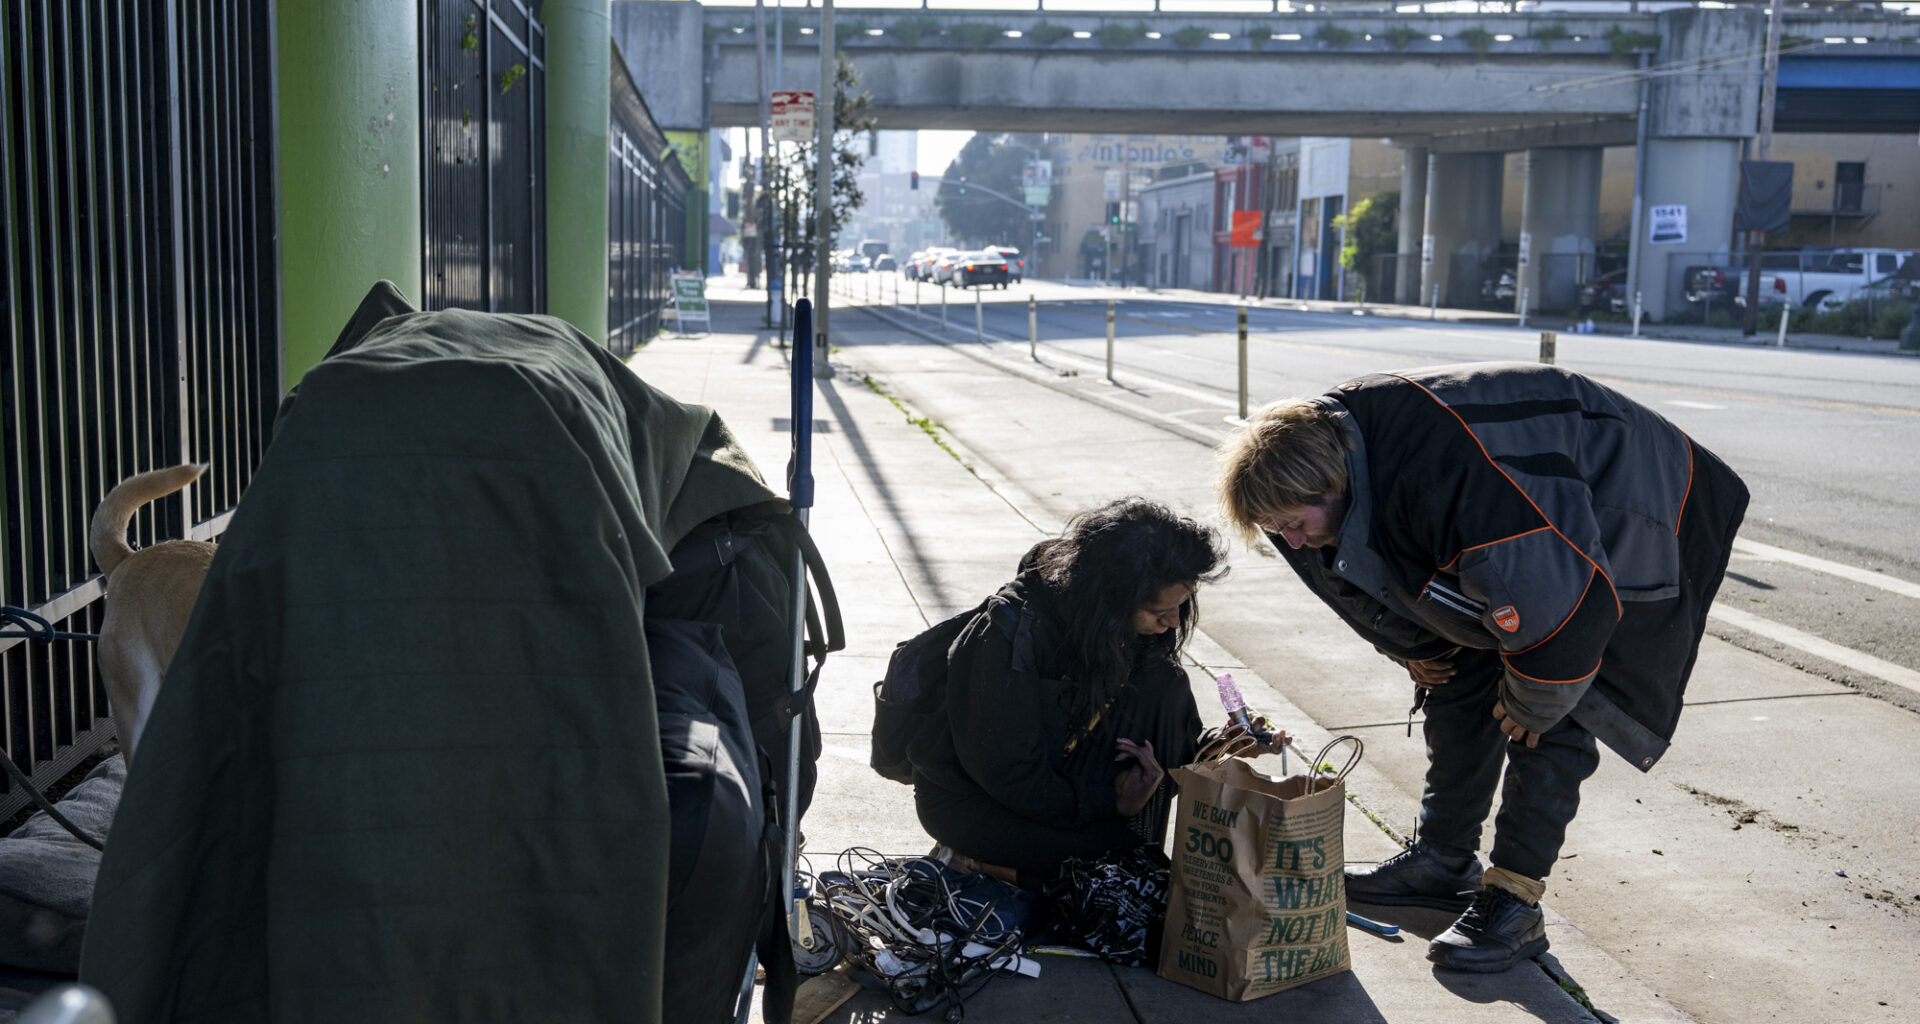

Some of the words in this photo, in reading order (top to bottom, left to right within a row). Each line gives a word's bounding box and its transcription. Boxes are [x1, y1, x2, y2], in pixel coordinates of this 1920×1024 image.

[793, 119, 810, 127] TIME
[1655, 208, 1682, 217] 1541
[1192, 799, 1208, 820] WE
[1210, 806, 1239, 828] BAN
[1185, 826, 1234, 863] 300
[1274, 835, 1327, 871] IT'S
[1180, 922, 1219, 949] PEACE
[1265, 912, 1322, 946] NOT
[1321, 906, 1339, 941] IN
[1178, 949, 1217, 979] MIND
[1260, 949, 1311, 982] THE
